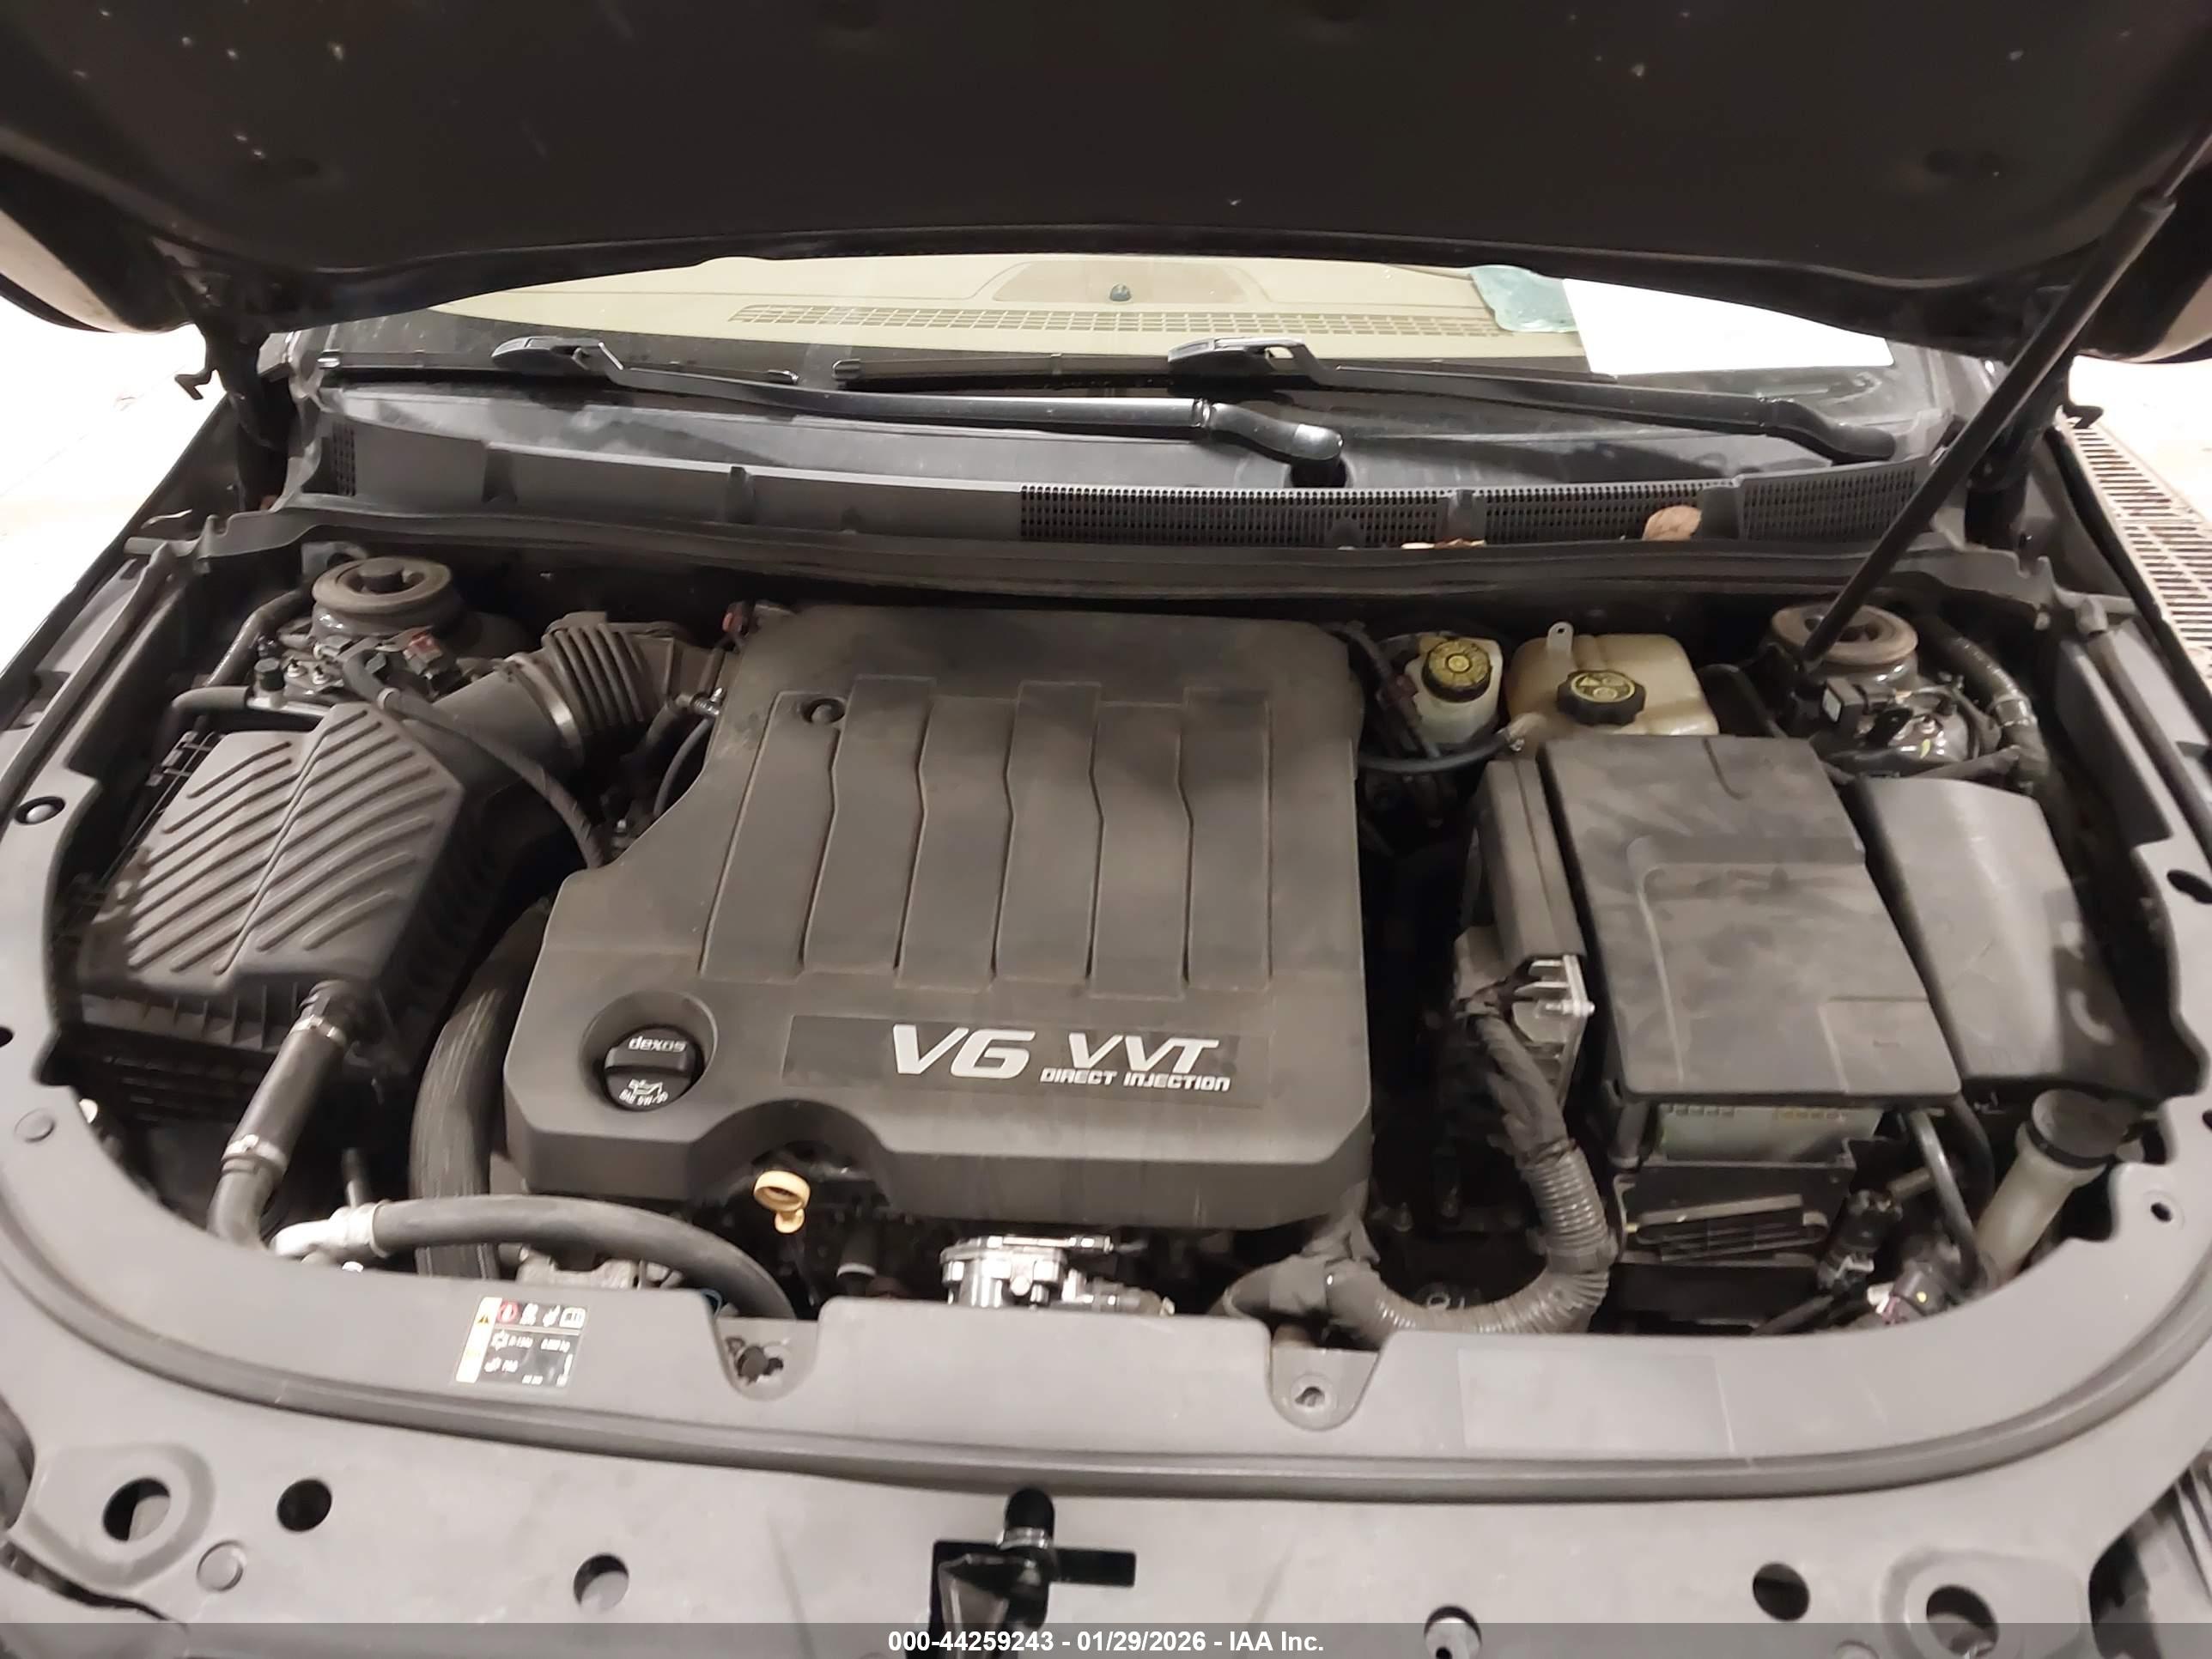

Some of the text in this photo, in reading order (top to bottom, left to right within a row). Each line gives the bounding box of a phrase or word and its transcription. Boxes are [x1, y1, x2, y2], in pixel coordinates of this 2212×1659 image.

[628, 1036, 686, 1053] dexos
[893, 1024, 1219, 1079] V6 VVT
[1040, 1067, 1231, 1091] DIRECT INJECTION
